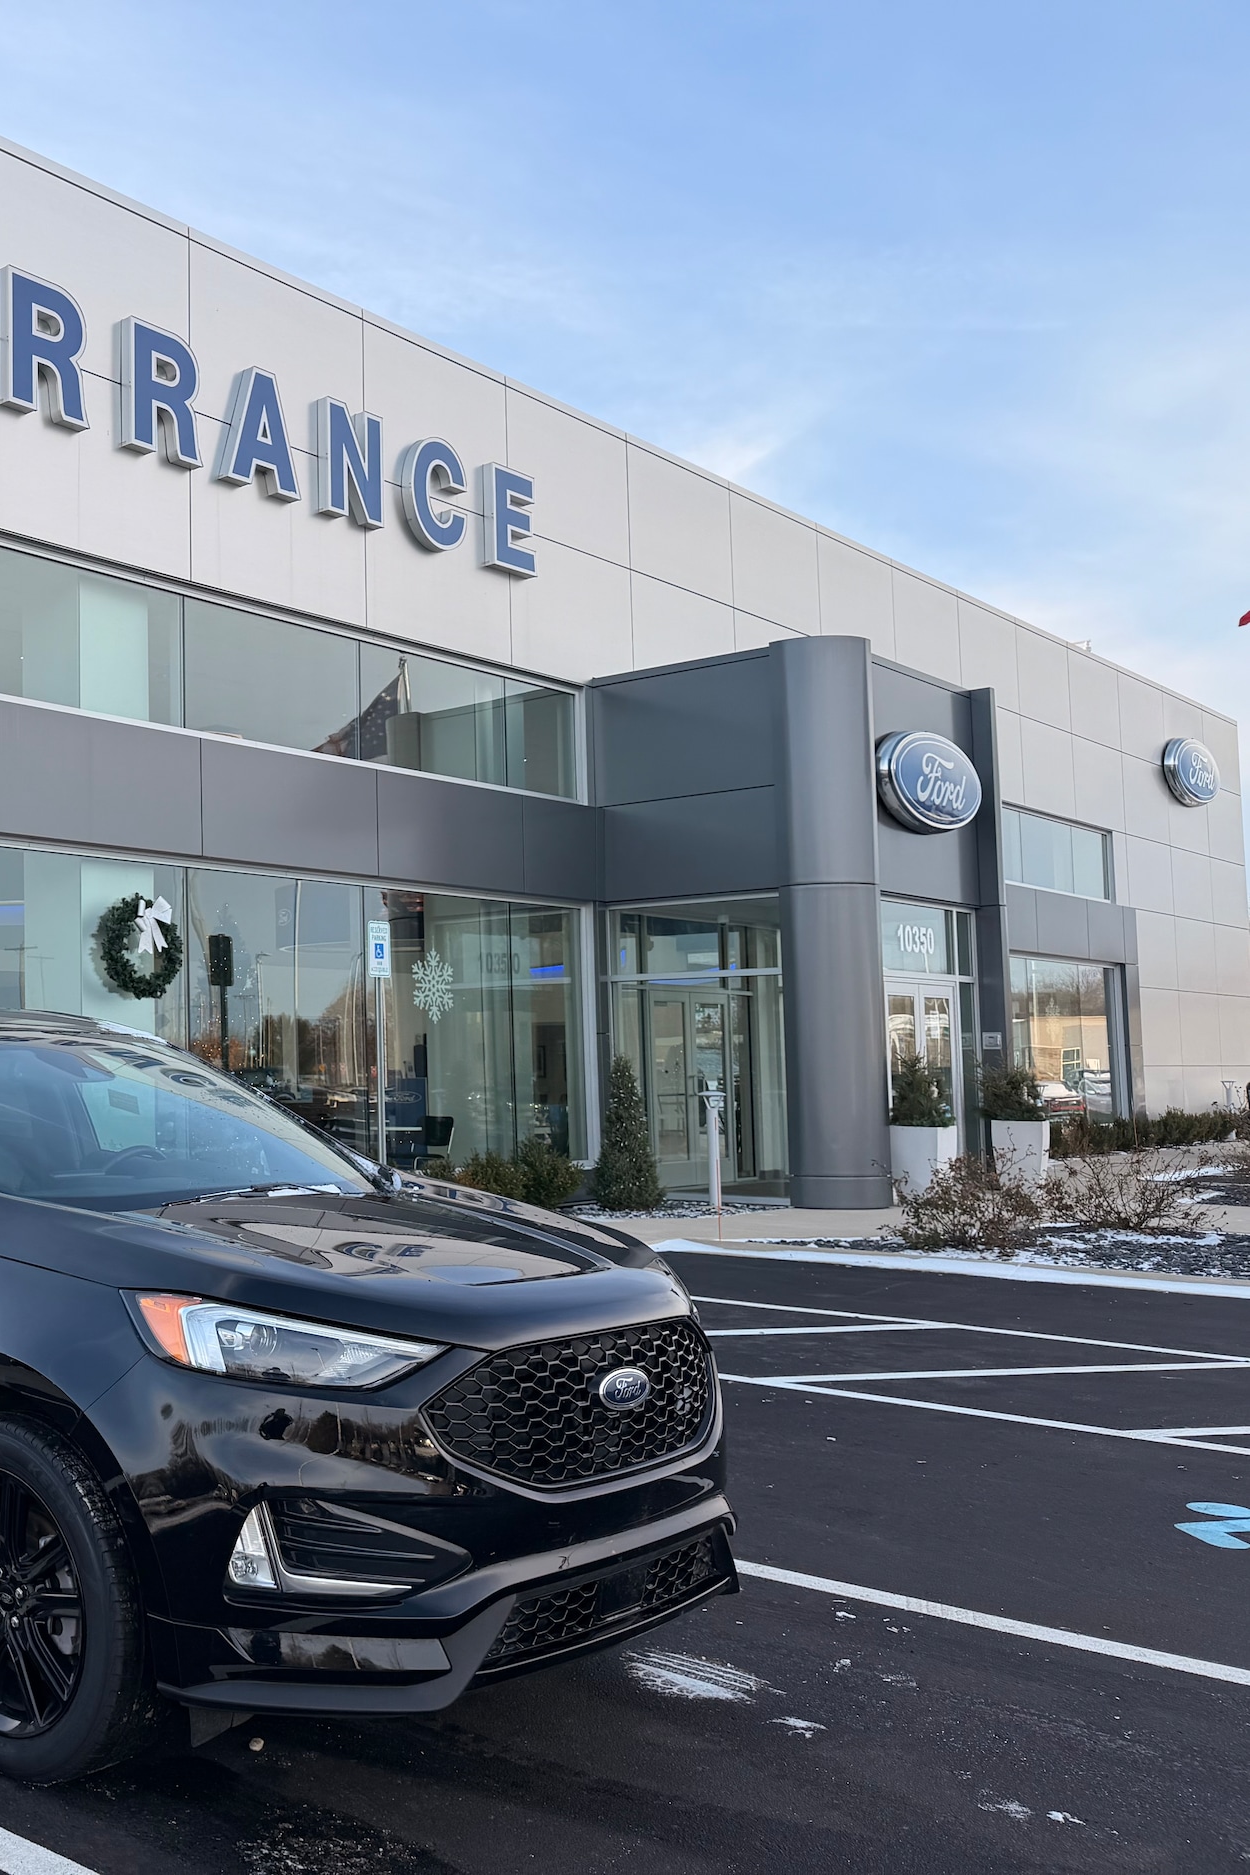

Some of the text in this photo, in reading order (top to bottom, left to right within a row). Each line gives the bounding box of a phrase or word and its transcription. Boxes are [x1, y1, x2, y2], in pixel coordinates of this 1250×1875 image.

[917, 753, 966, 811] Ford
[1189, 751, 1215, 790] Ford
[897, 924, 934, 954] 10350
[614, 1376, 642, 1400] Ford
